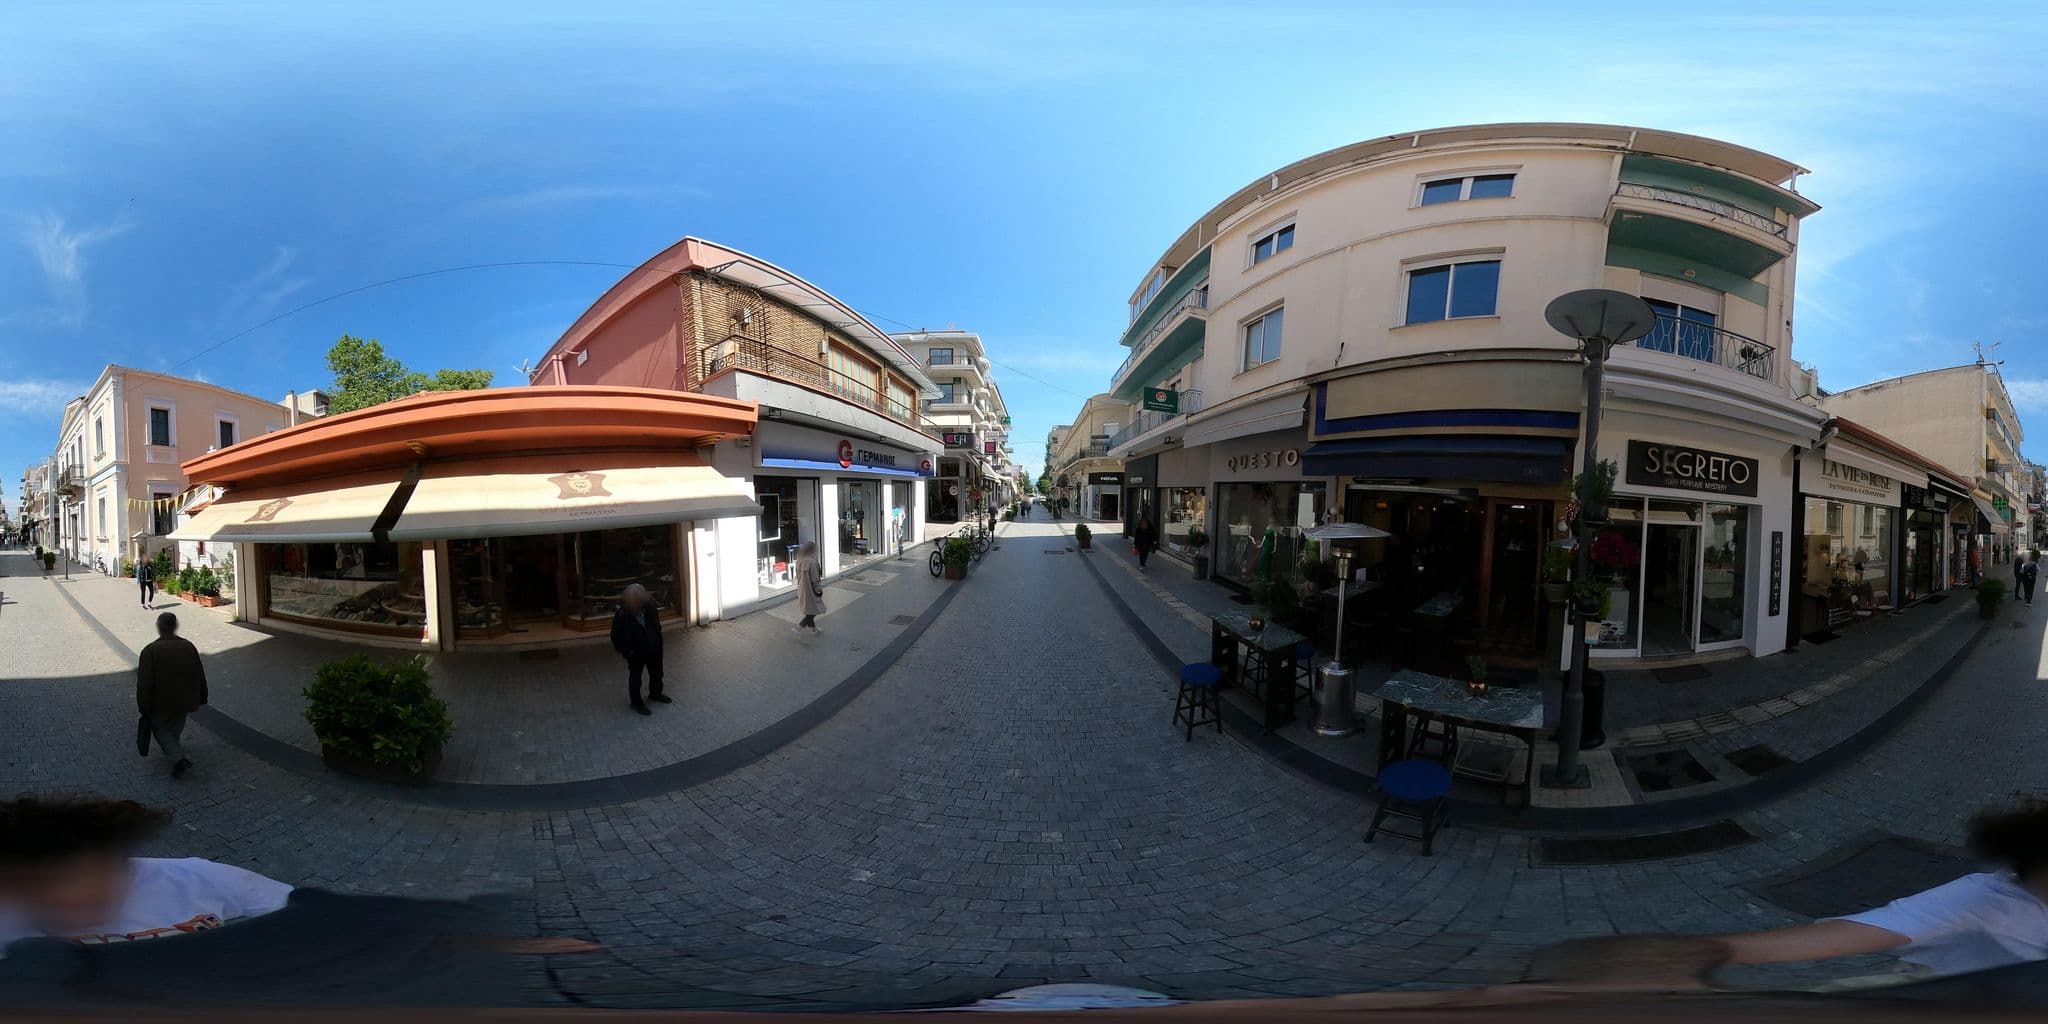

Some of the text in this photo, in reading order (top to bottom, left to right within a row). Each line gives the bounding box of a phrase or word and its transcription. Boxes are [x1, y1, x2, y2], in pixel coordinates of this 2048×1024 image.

[858, 449, 896, 466] ΓΕΡΜΑΝΟΣ
[1226, 449, 1299, 472] QUESTO
[1645, 447, 1750, 484] SEGRETO
[1822, 459, 1839, 478] LA
[1841, 464, 1860, 482] VIE
[1704, 482, 1728, 492] MYSTERY
